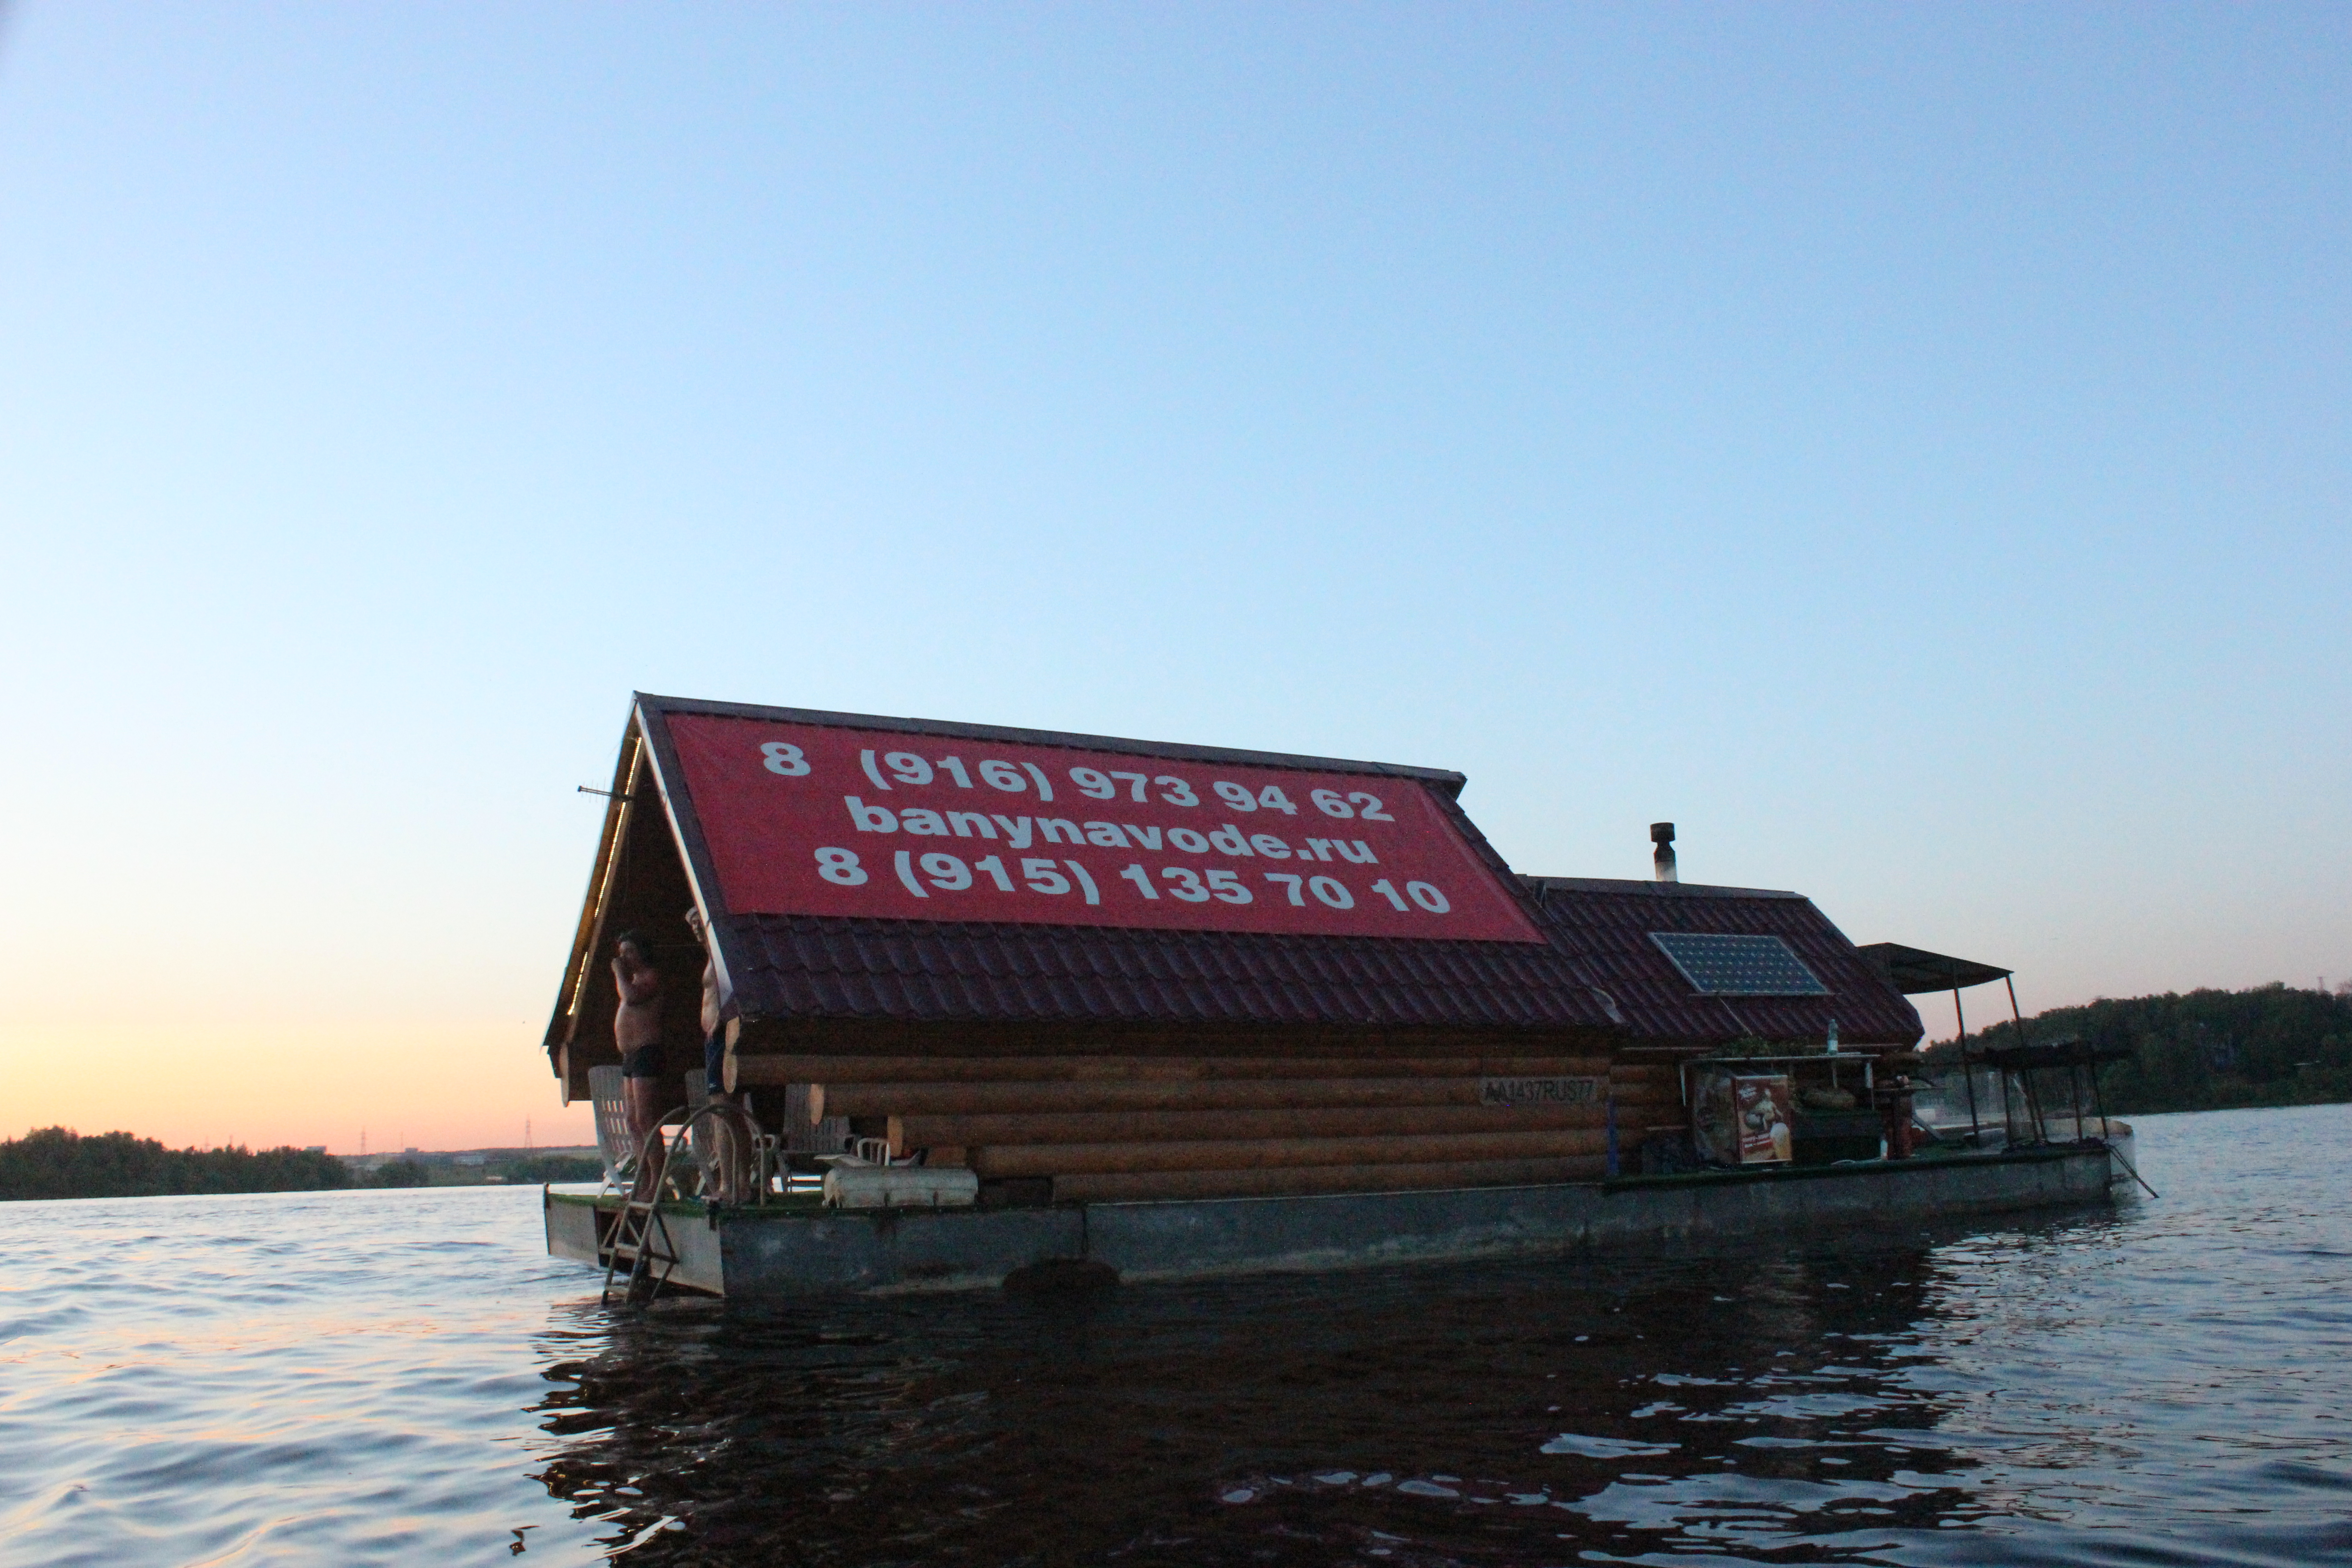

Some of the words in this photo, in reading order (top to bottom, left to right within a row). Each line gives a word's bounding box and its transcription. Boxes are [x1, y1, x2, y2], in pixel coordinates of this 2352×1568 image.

[760, 742, 810, 776] 8
[861, 750, 1053, 801] (916)
[1069, 767, 1199, 806] 973
[1213, 781, 1297, 818] 94
[1311, 789, 1394, 821] 62
[844, 796, 1378, 863] banynavode.ru
[814, 847, 867, 885] 8
[895, 851, 1099, 905] (915)
[1121, 864, 1253, 904] 135
[1264, 873, 1354, 909] 70
[1372, 879, 1450, 913] 10
